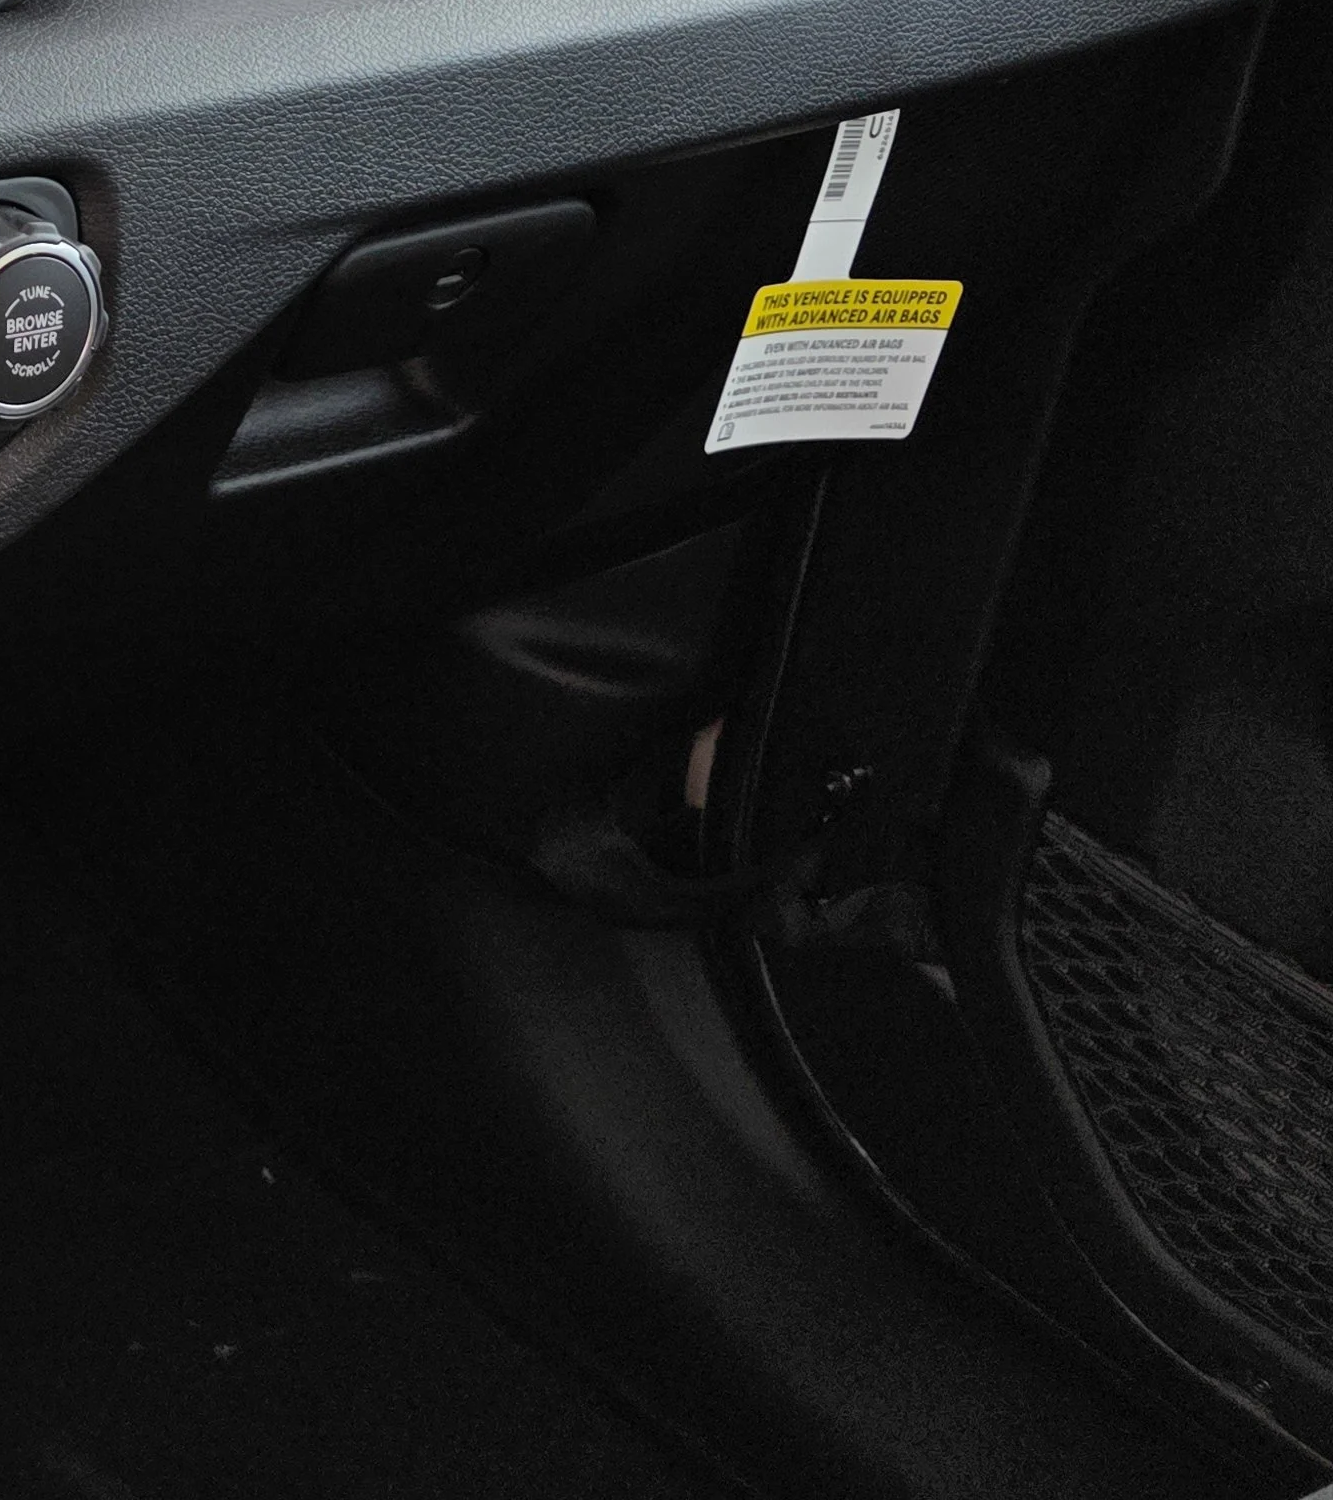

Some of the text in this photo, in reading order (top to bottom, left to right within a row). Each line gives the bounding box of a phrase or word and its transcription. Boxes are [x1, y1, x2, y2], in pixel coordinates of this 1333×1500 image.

[19, 285, 52, 302] TUNE
[763, 290, 948, 311] THIS VEHICLE IS EQUIPPED
[6, 309, 63, 334] BROWSE
[756, 308, 942, 331] WITH ADVANCED AIR BAGS
[13, 332, 58, 353] ENTER
[809, 338, 861, 351] ADVANCED
[862, 338, 878, 350] AIR
[878, 338, 904, 350] BAGS
[12, 357, 56, 377] SCROLL
